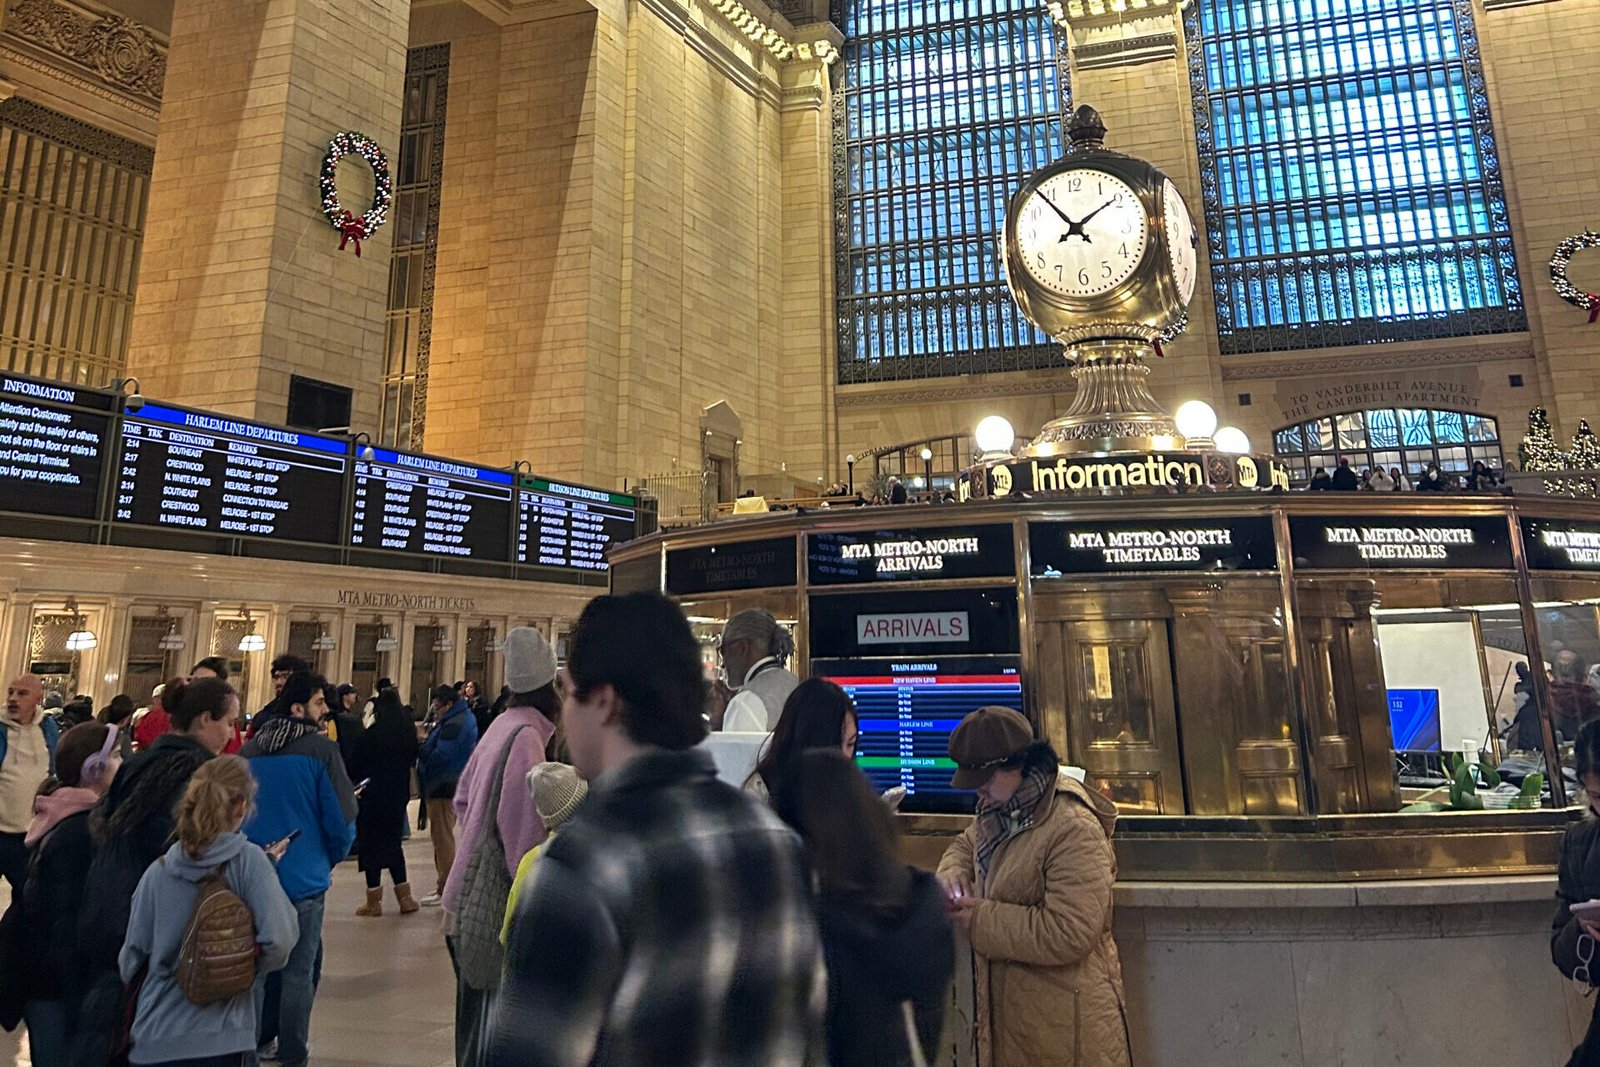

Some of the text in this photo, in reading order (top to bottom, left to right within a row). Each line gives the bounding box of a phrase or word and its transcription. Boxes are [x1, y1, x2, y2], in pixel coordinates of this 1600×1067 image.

[1068, 178, 1081, 192] 12
[1047, 188, 1056, 201] 11
[1113, 193, 1123, 208] 2
[1031, 206, 1041, 220] 10
[1121, 220, 1132, 234] 3
[1029, 230, 1036, 245] 9
[1118, 242, 1129, 258] 4
[1178, 248, 1182, 264] 8
[1037, 252, 1045, 269] 8
[1101, 261, 1112, 278] 5
[1054, 265, 1063, 282] 7
[1078, 268, 1089, 285] 6
[4, 379, 75, 402] INFORMATION
[1291, 381, 1467, 405] TO VANDERBILT AVENUE
[0, 402, 72, 423] Attention Customers:
[1283, 393, 1481, 420] THE CAMPBELL APARTMENT
[19, 422, 33, 432] and
[34, 423, 46, 433] the
[47, 426, 68, 439] safety
[68, 430, 76, 438] of
[76, 431, 99, 443] others,
[185, 414, 299, 445] HARLEM LINE DEPARTURES
[12, 436, 22, 445] sit
[22, 439, 32, 447] on
[33, 438, 45, 448] the
[46, 440, 62, 450] floor
[62, 443, 70, 452] or
[71, 444, 89, 455] stairs
[90, 446, 97, 456] in
[123, 424, 257, 454] TIME TRK DESTINATION REMARKS
[12, 450, 70, 467] Central Terminal.
[126, 439, 140, 448] 2:14
[168, 446, 203, 458] SOUTHEAST
[227, 455, 244, 465] WHITE
[245, 458, 263, 468] PLAINS
[10, 466, 80, 484] for your cooperation.
[125, 453, 138, 462] 2:17
[166, 459, 204, 472] CRESTWOOD
[226, 468, 252, 479] MELROSE
[264, 474, 279, 483] STOP
[397, 454, 478, 478] HARLEM LINE DEPARTURES
[1031, 455, 1203, 491] Information
[172, 474, 190, 484] WHITE
[190, 477, 211, 486] PLAINS
[224, 481, 250, 492] MELROSE
[263, 487, 277, 495] STOP
[549, 483, 569, 496] HUDSON
[163, 486, 198, 498] SOUTHEAST
[223, 494, 257, 505] CONNECTION
[161, 500, 199, 512] CRESTWOOD
[221, 507, 248, 518] MELROSE
[167, 515, 186, 525] WHITE
[186, 517, 207, 527] PLAINS
[220, 521, 246, 531] MELROSE
[259, 526, 274, 534] STOP
[1069, 530, 1231, 548] MTA METRO-NORTH
[1326, 527, 1473, 543] MTA METRO-NORTH
[1542, 531, 1569, 546] MTA
[842, 538, 978, 558] MTA METRO-NORTH
[1103, 547, 1200, 563] TIMETABLES
[1358, 544, 1447, 559] TIMETABLES
[1565, 548, 1600, 562] TIMET
[876, 555, 943, 572] ARRIVALS
[338, 590, 475, 610] MTA METRO-NORTH TICKETS
[862, 616, 964, 639] ARRIVALS
